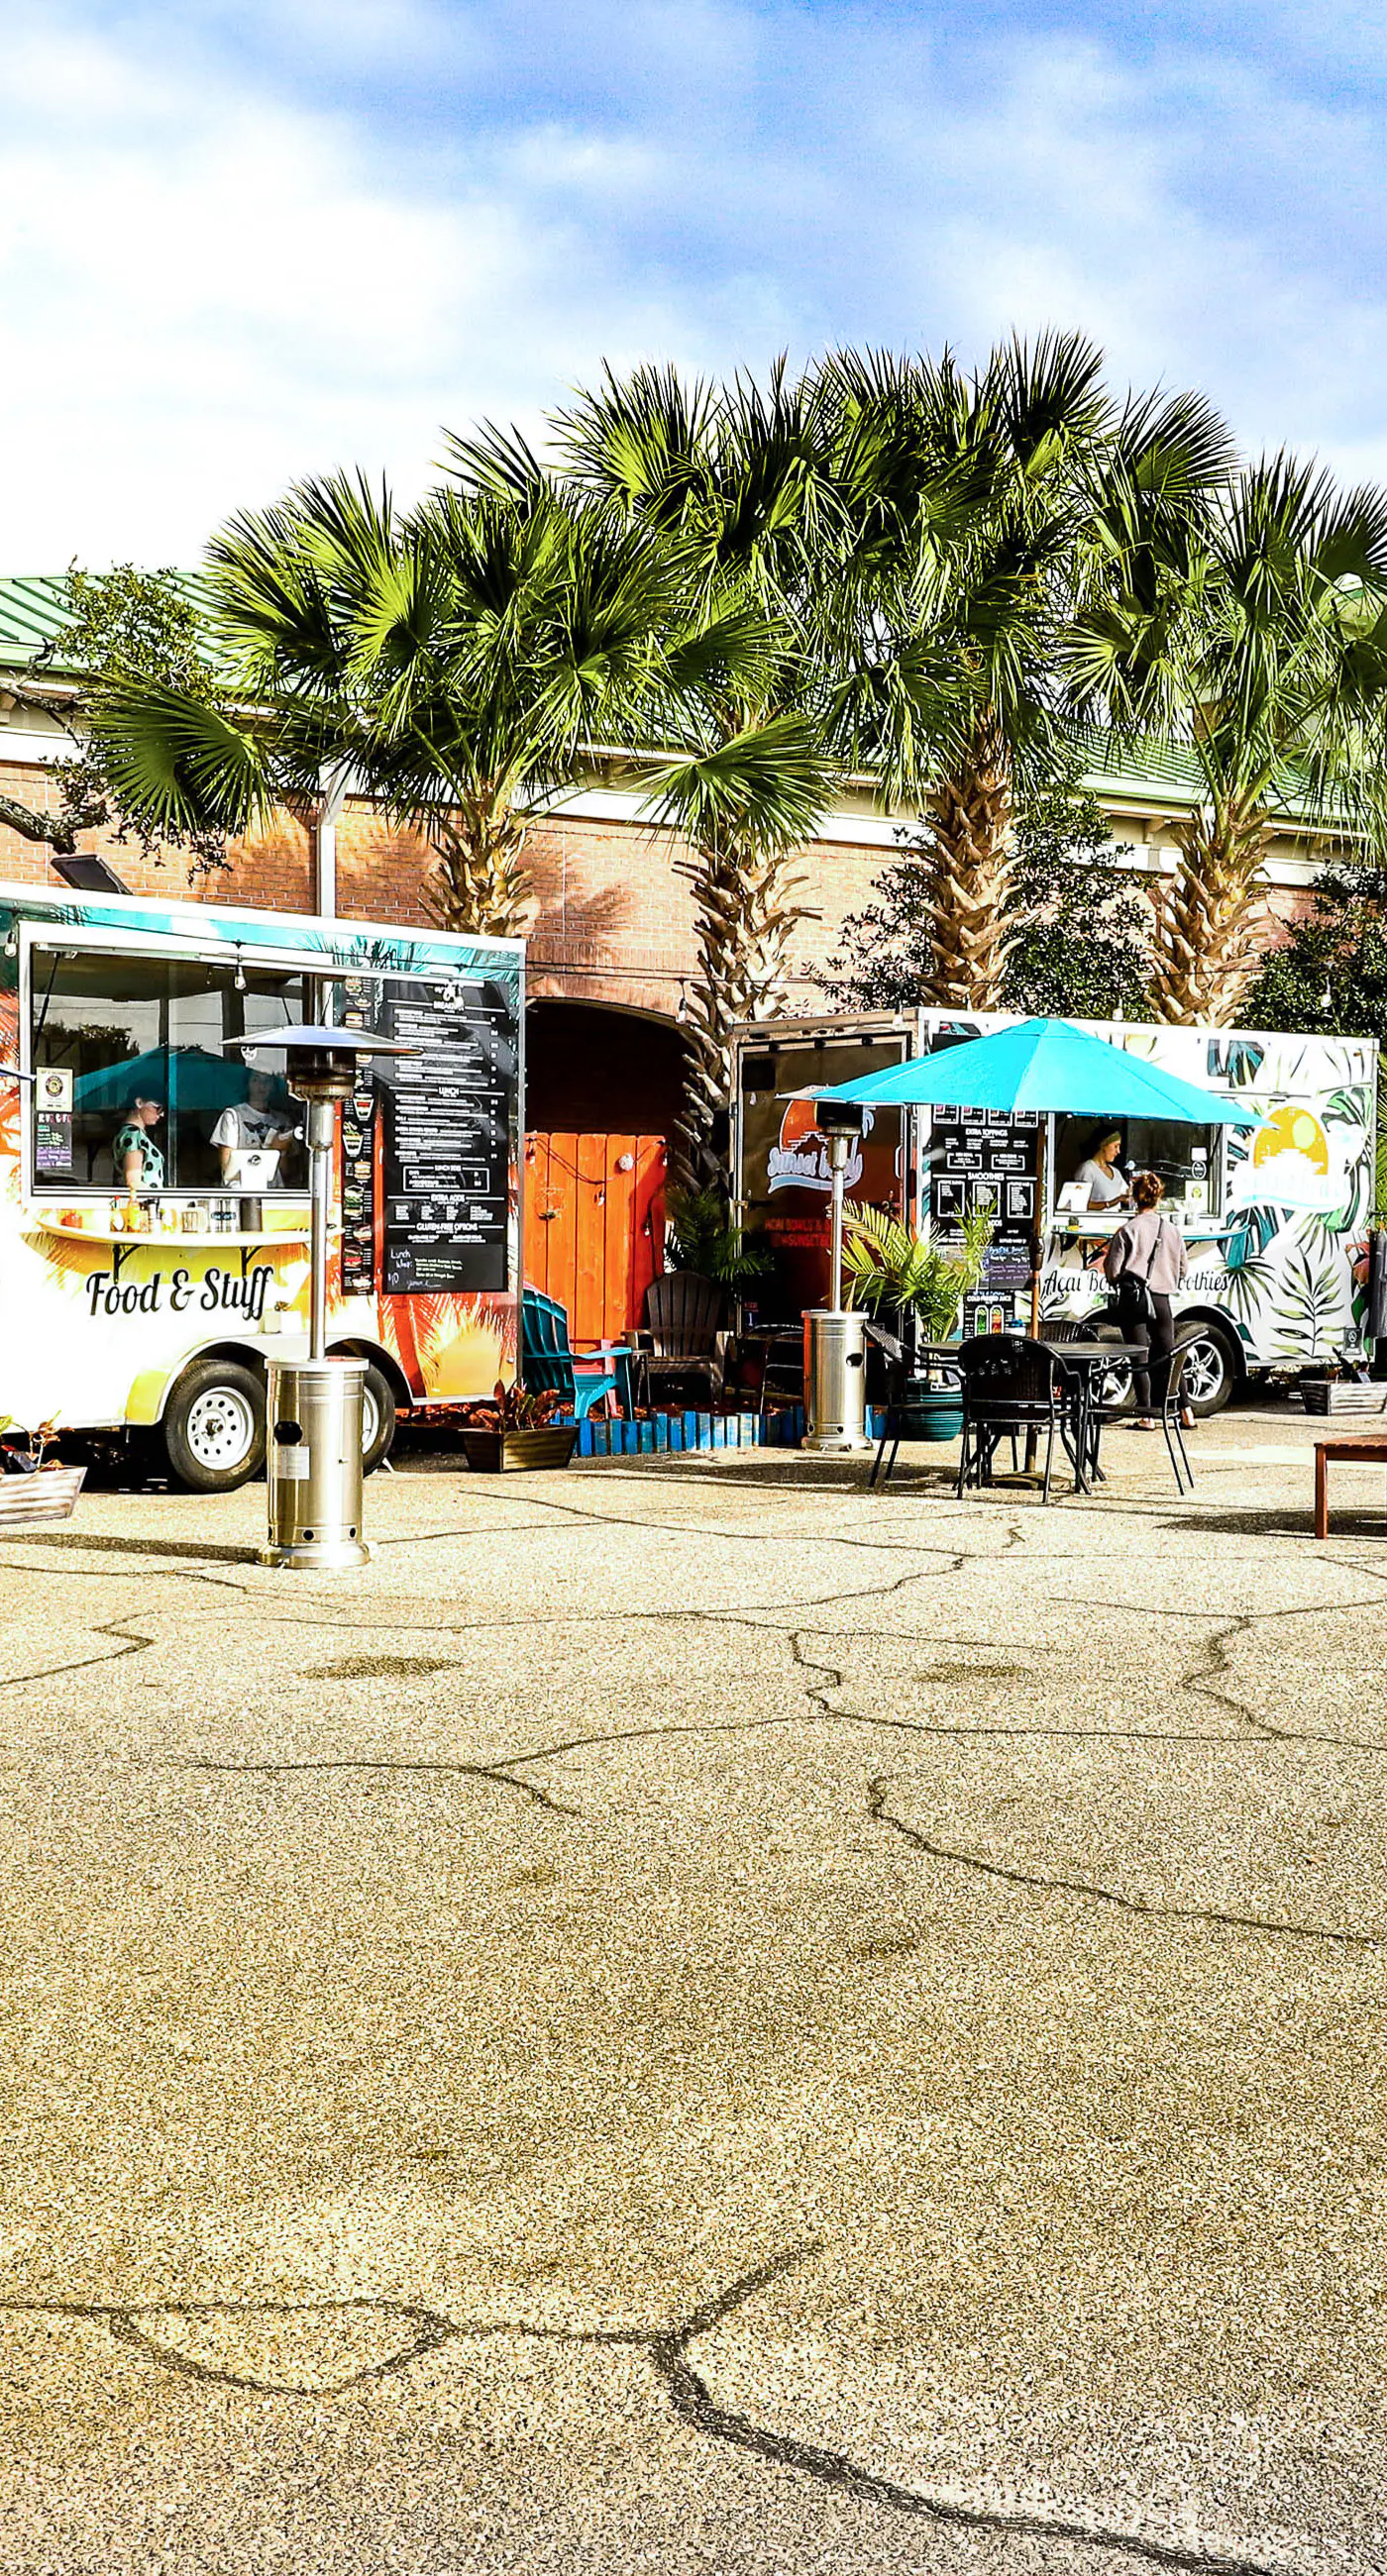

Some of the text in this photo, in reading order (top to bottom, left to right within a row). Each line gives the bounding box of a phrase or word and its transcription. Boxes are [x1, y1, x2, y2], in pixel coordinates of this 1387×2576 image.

[967, 1172, 1005, 1182] SMOOTHIES
[1177, 1271, 1229, 1291] oothies
[86, 1266, 274, 1321] Food & Stuff
